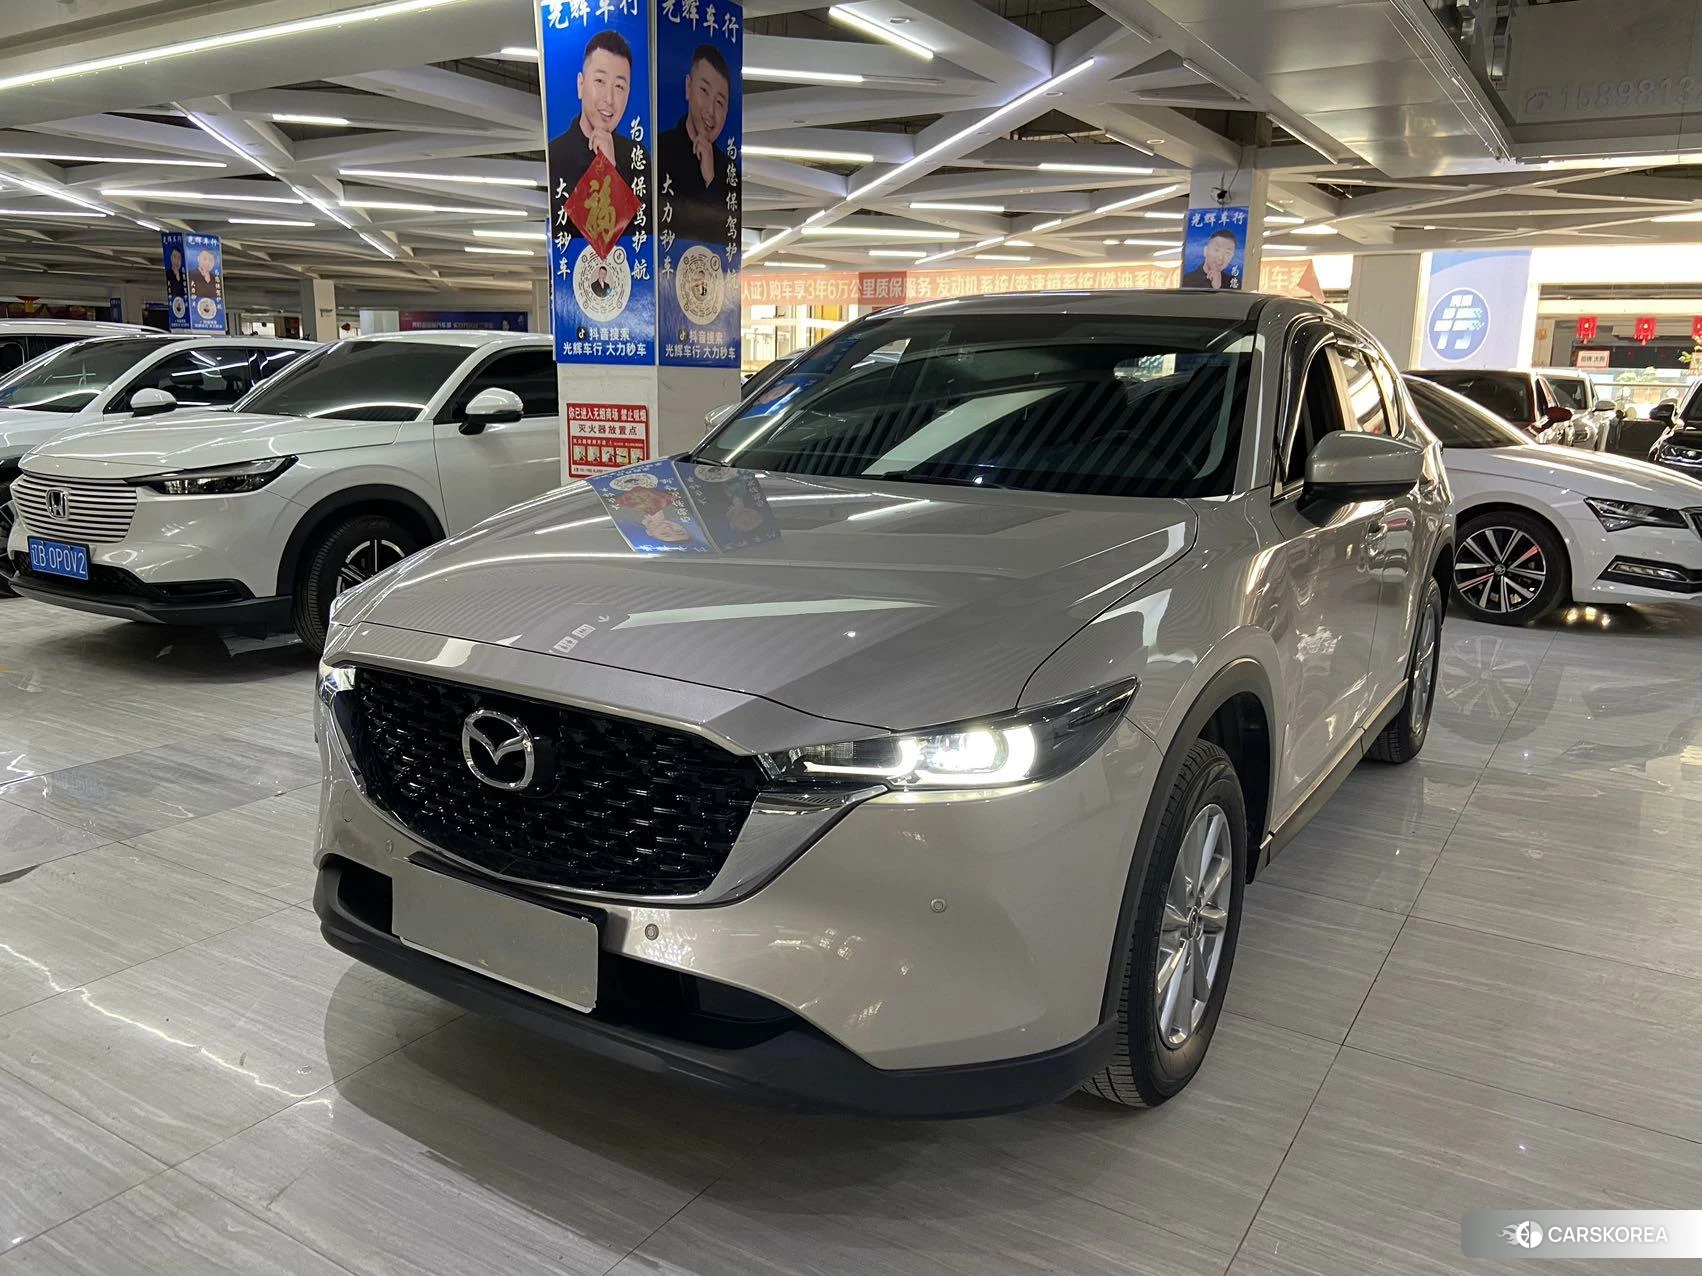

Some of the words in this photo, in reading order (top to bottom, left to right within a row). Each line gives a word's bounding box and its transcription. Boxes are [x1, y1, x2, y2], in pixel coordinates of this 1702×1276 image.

[725, 138, 738, 289] 为您保驾护航
[659, 173, 676, 279] 大力秒车
[589, 327, 630, 341] 抖音搜索
[563, 342, 602, 356] 光辉车行
[606, 342, 647, 357] 大力秒车
[665, 344, 701, 358] 光辉车行
[703, 346, 736, 360] 大力秒车
[578, 424, 637, 436] 灭火器放置点
